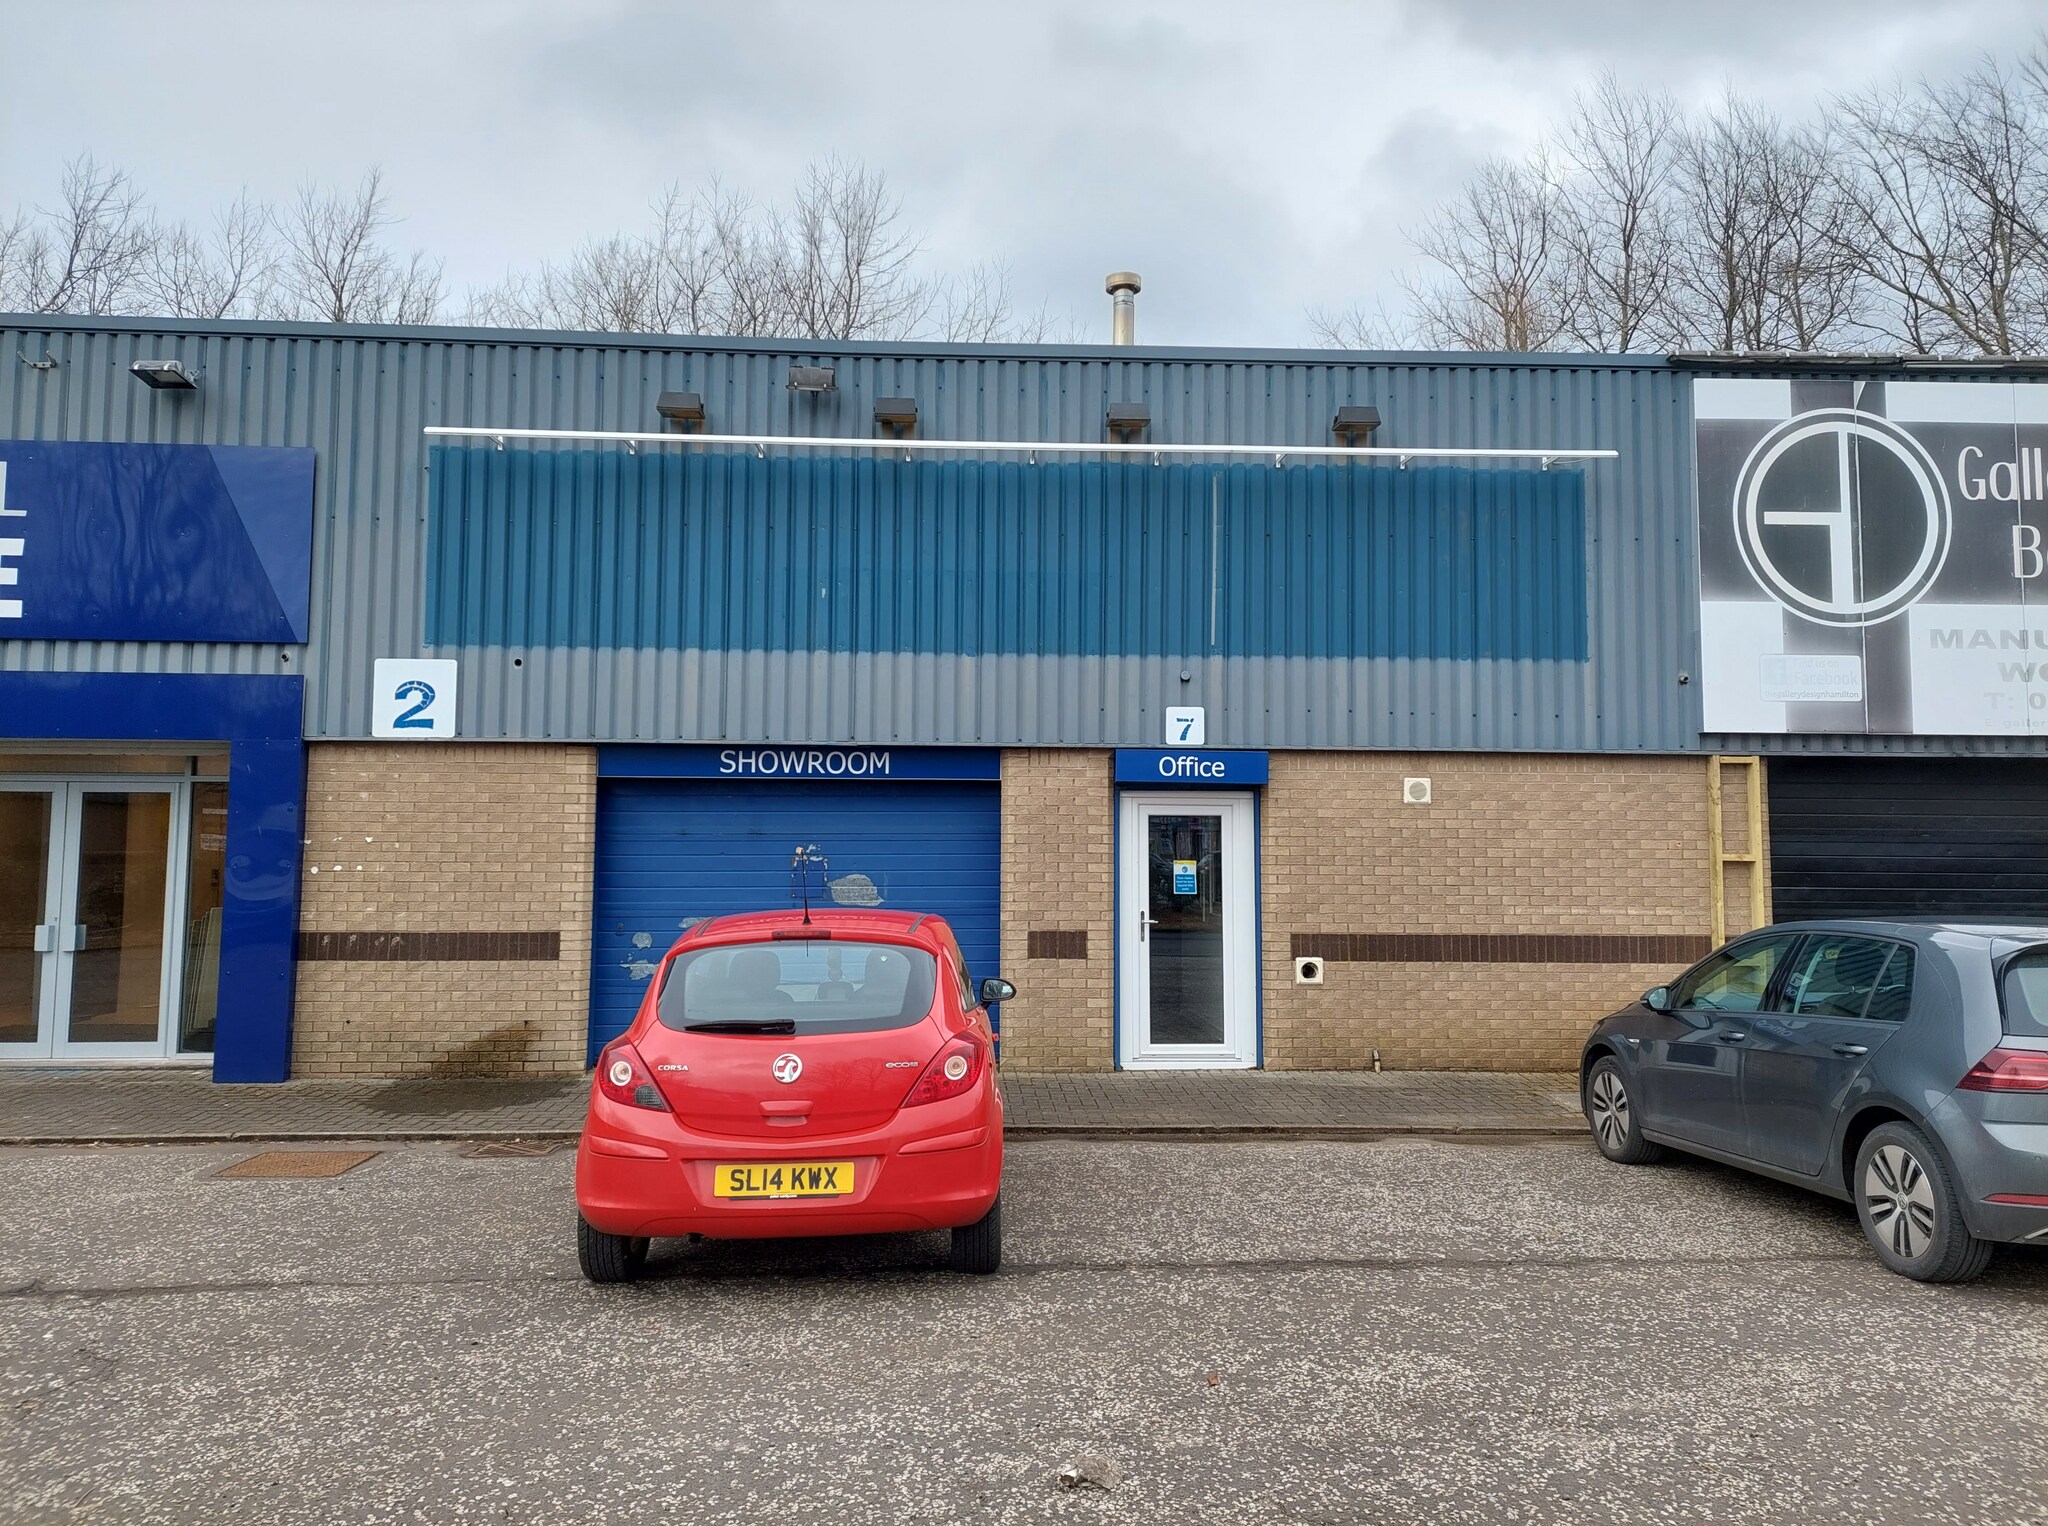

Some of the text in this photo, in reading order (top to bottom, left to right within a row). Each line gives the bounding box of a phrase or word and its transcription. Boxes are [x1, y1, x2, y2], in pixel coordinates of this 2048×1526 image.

[1958, 446, 2048, 501] Gall
[2012, 525, 2048, 579] B
[393, 680, 435, 730] 2
[1176, 718, 1194, 741] 7
[719, 750, 890, 775] SHOWROOM
[1159, 756, 1225, 777] Office
[730, 1167, 838, 1192] SL14 KWX
